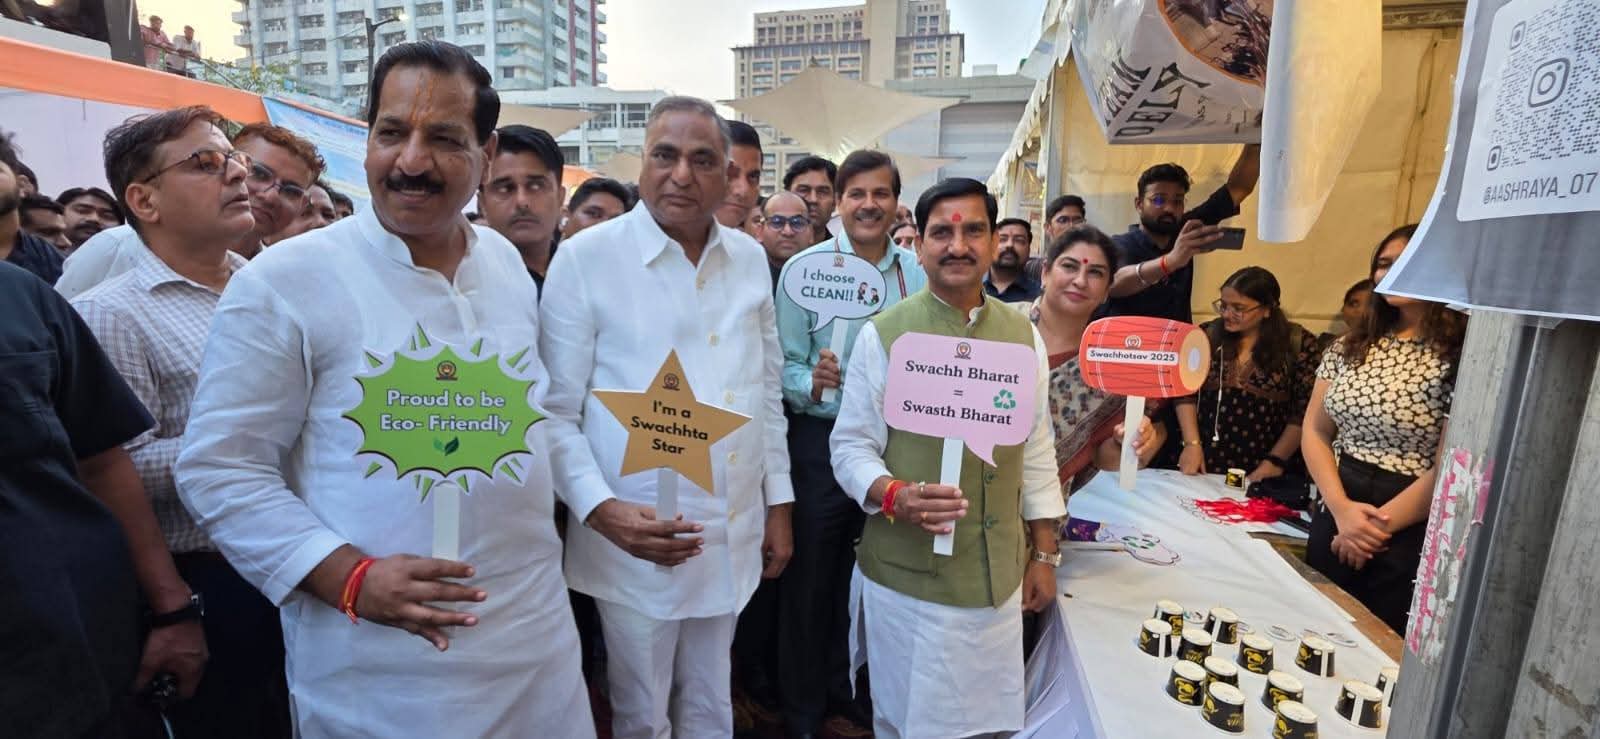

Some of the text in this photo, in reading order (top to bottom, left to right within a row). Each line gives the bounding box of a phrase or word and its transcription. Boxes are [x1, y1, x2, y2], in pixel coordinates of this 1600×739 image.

[802, 268, 856, 284] I choose
[800, 286, 854, 302] CLEAN!!
[1089, 350, 1175, 362] Swachhotsav 2025
[905, 360, 1020, 385] Swachh Bharat
[386, 388, 505, 408] Proud to be
[652, 400, 691, 419] I'm a
[902, 400, 1013, 425] Swasth Bharat
[379, 414, 512, 436] Eco- Friendly
[630, 416, 709, 441] Swachhta
[651, 438, 685, 455] Star
